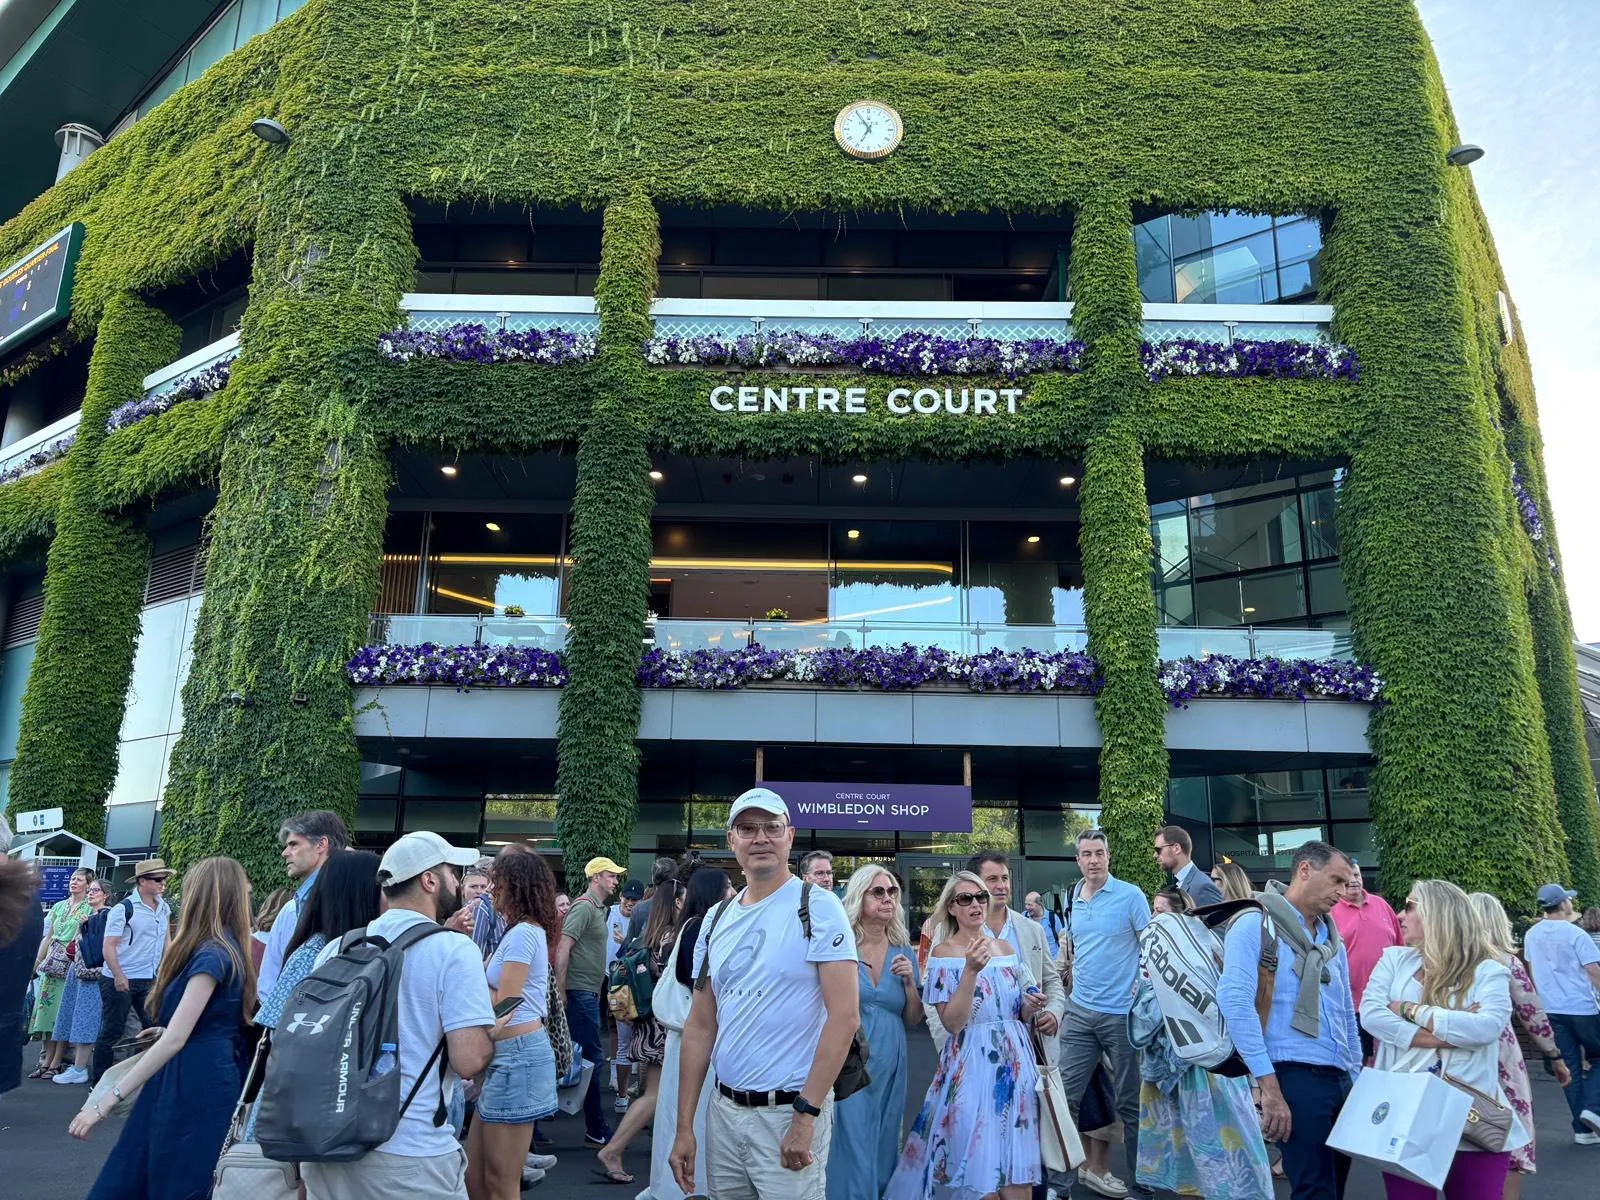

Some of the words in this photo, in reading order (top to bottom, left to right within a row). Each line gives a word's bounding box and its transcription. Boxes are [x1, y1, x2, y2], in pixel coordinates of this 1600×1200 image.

[709, 386, 866, 413] CENTRE
[887, 388, 1023, 414] COURT
[835, 792, 864, 800] CENTRE
[797, 802, 885, 815] WIMBLEDON
[891, 804, 929, 816] SHOP
[336, 1052, 349, 1113] ARMOUR
